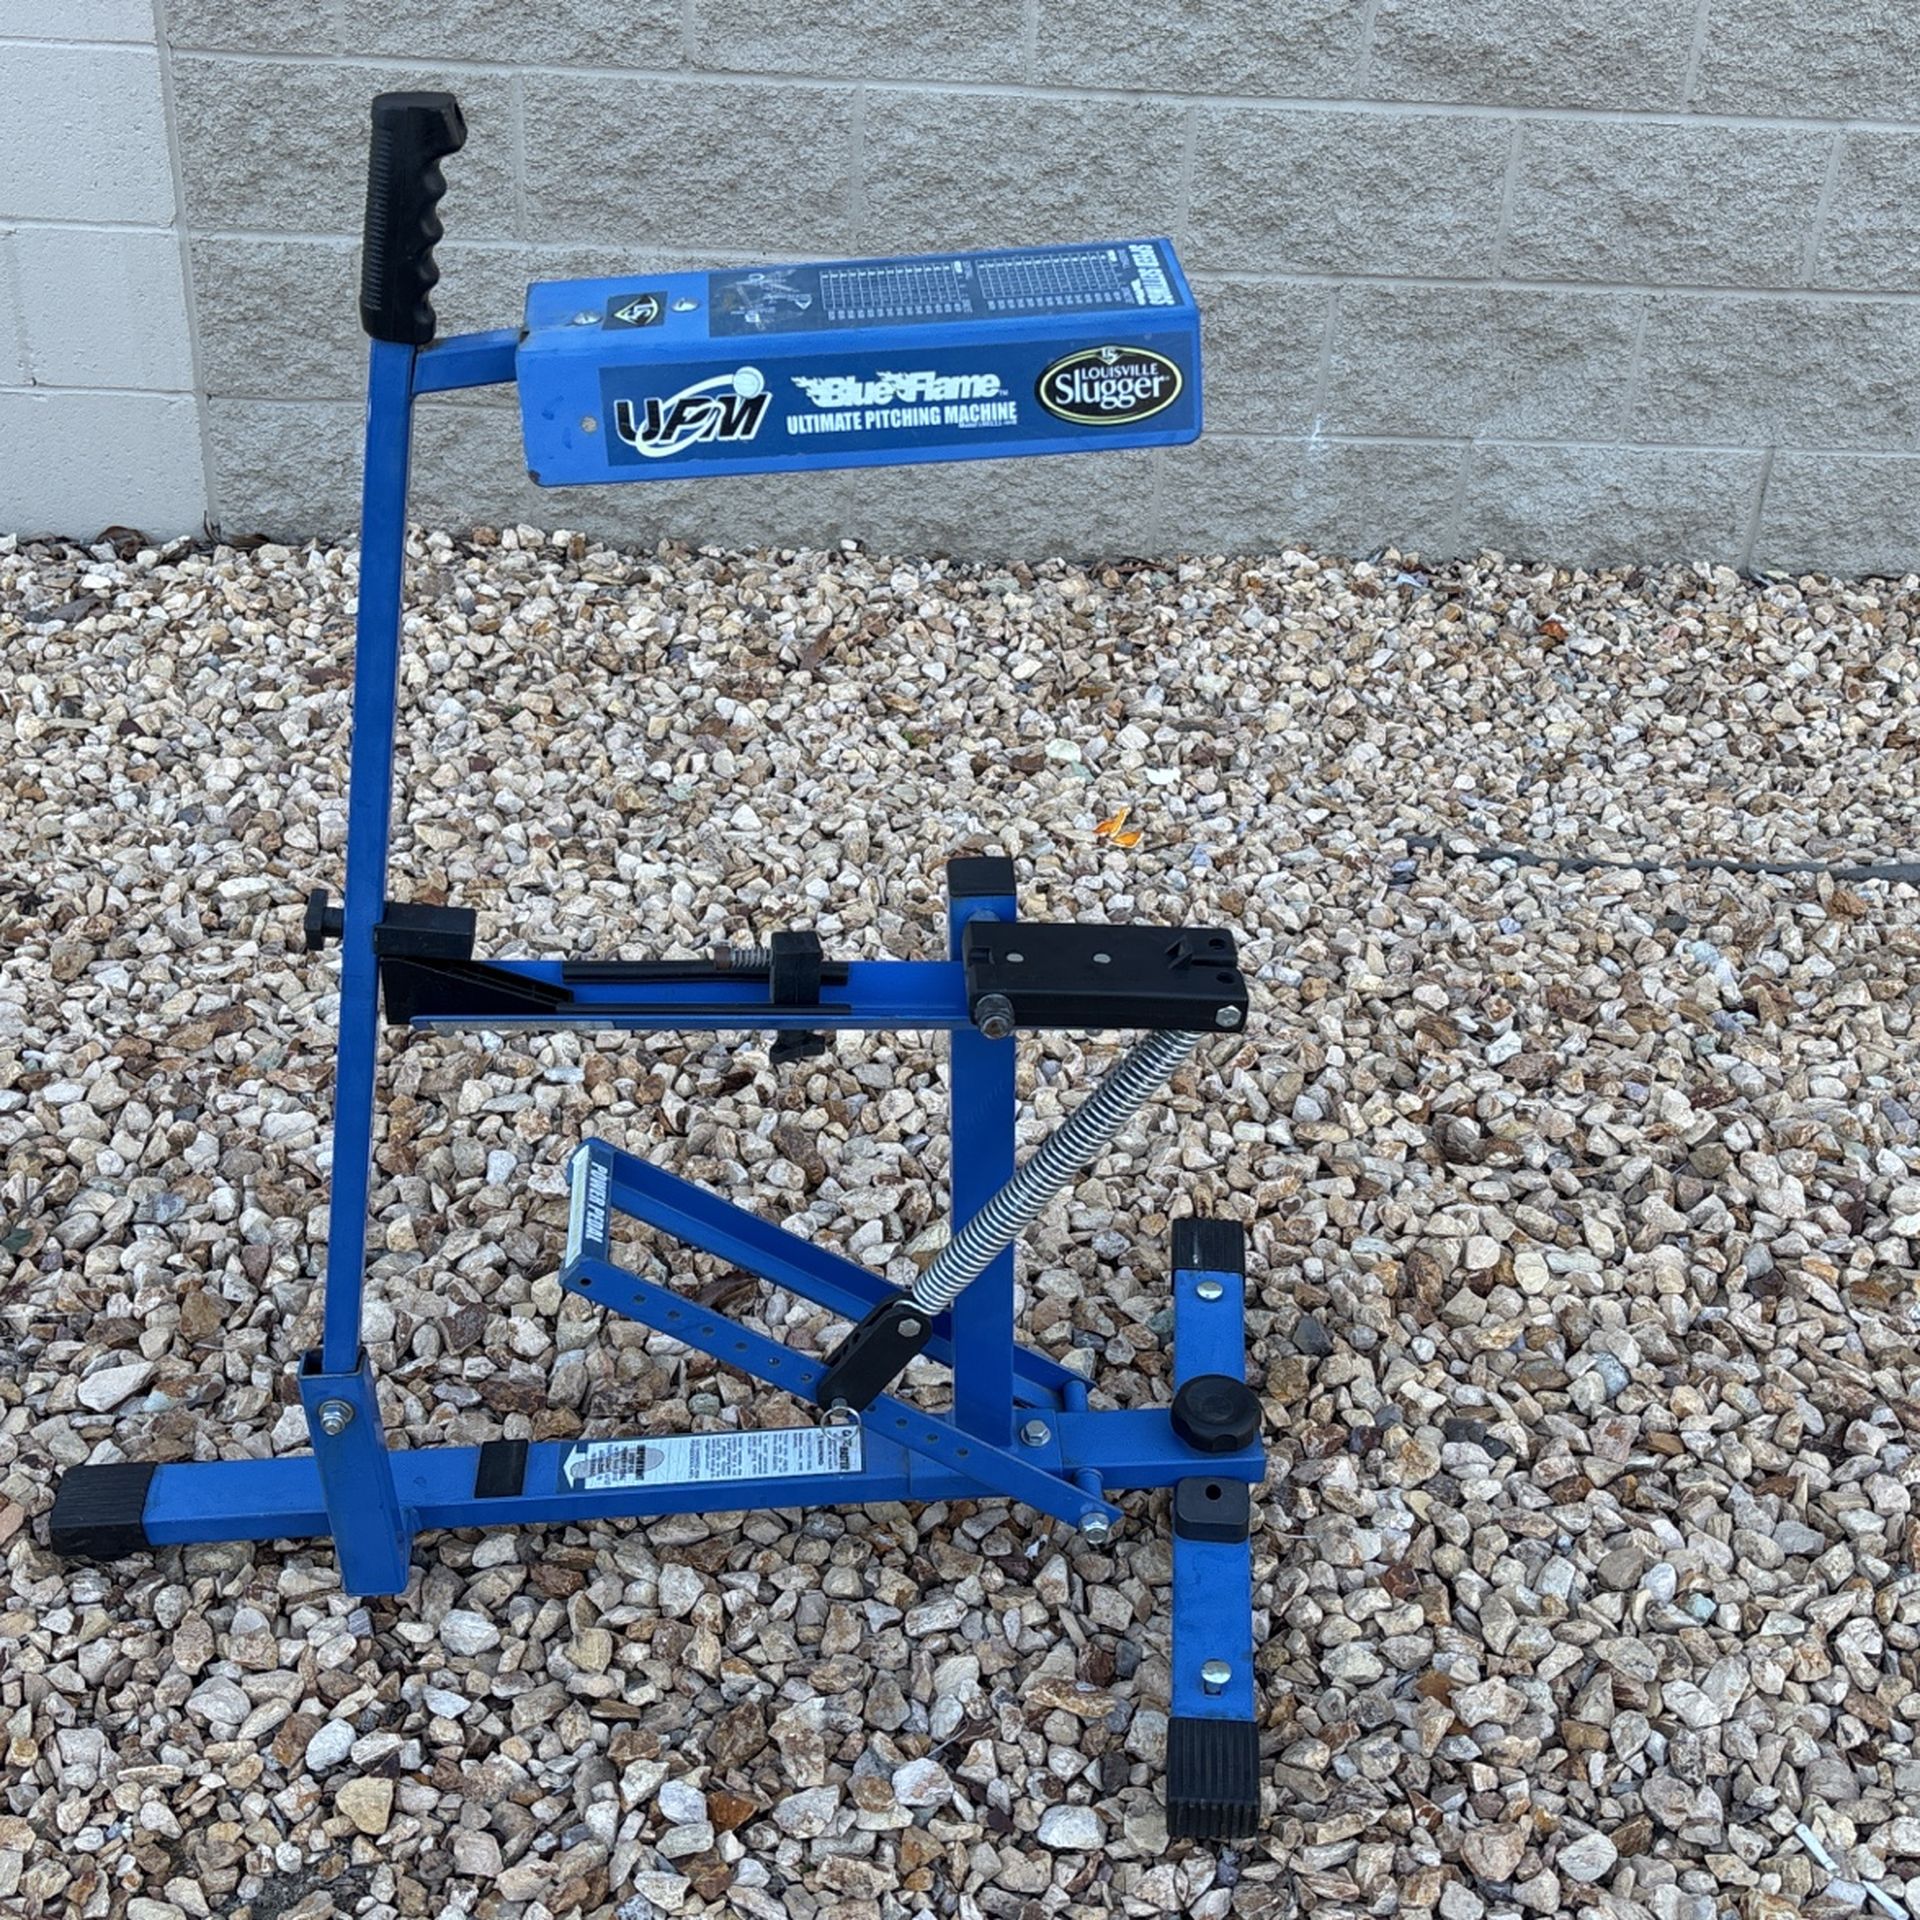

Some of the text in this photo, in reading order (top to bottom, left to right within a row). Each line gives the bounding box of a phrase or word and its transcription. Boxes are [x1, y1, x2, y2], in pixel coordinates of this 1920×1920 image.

[792, 375, 894, 408] Blue
[890, 371, 1000, 402] Flame
[1055, 368, 1163, 410] Slugger
[1081, 363, 1159, 380] LOUISVILLE
[614, 391, 772, 446] UPM
[786, 411, 863, 435] ULTIMATE
[864, 406, 941, 430] PITCHING
[944, 401, 1017, 424] MACHINE
[585, 1161, 608, 1244] POWER PEDAL
